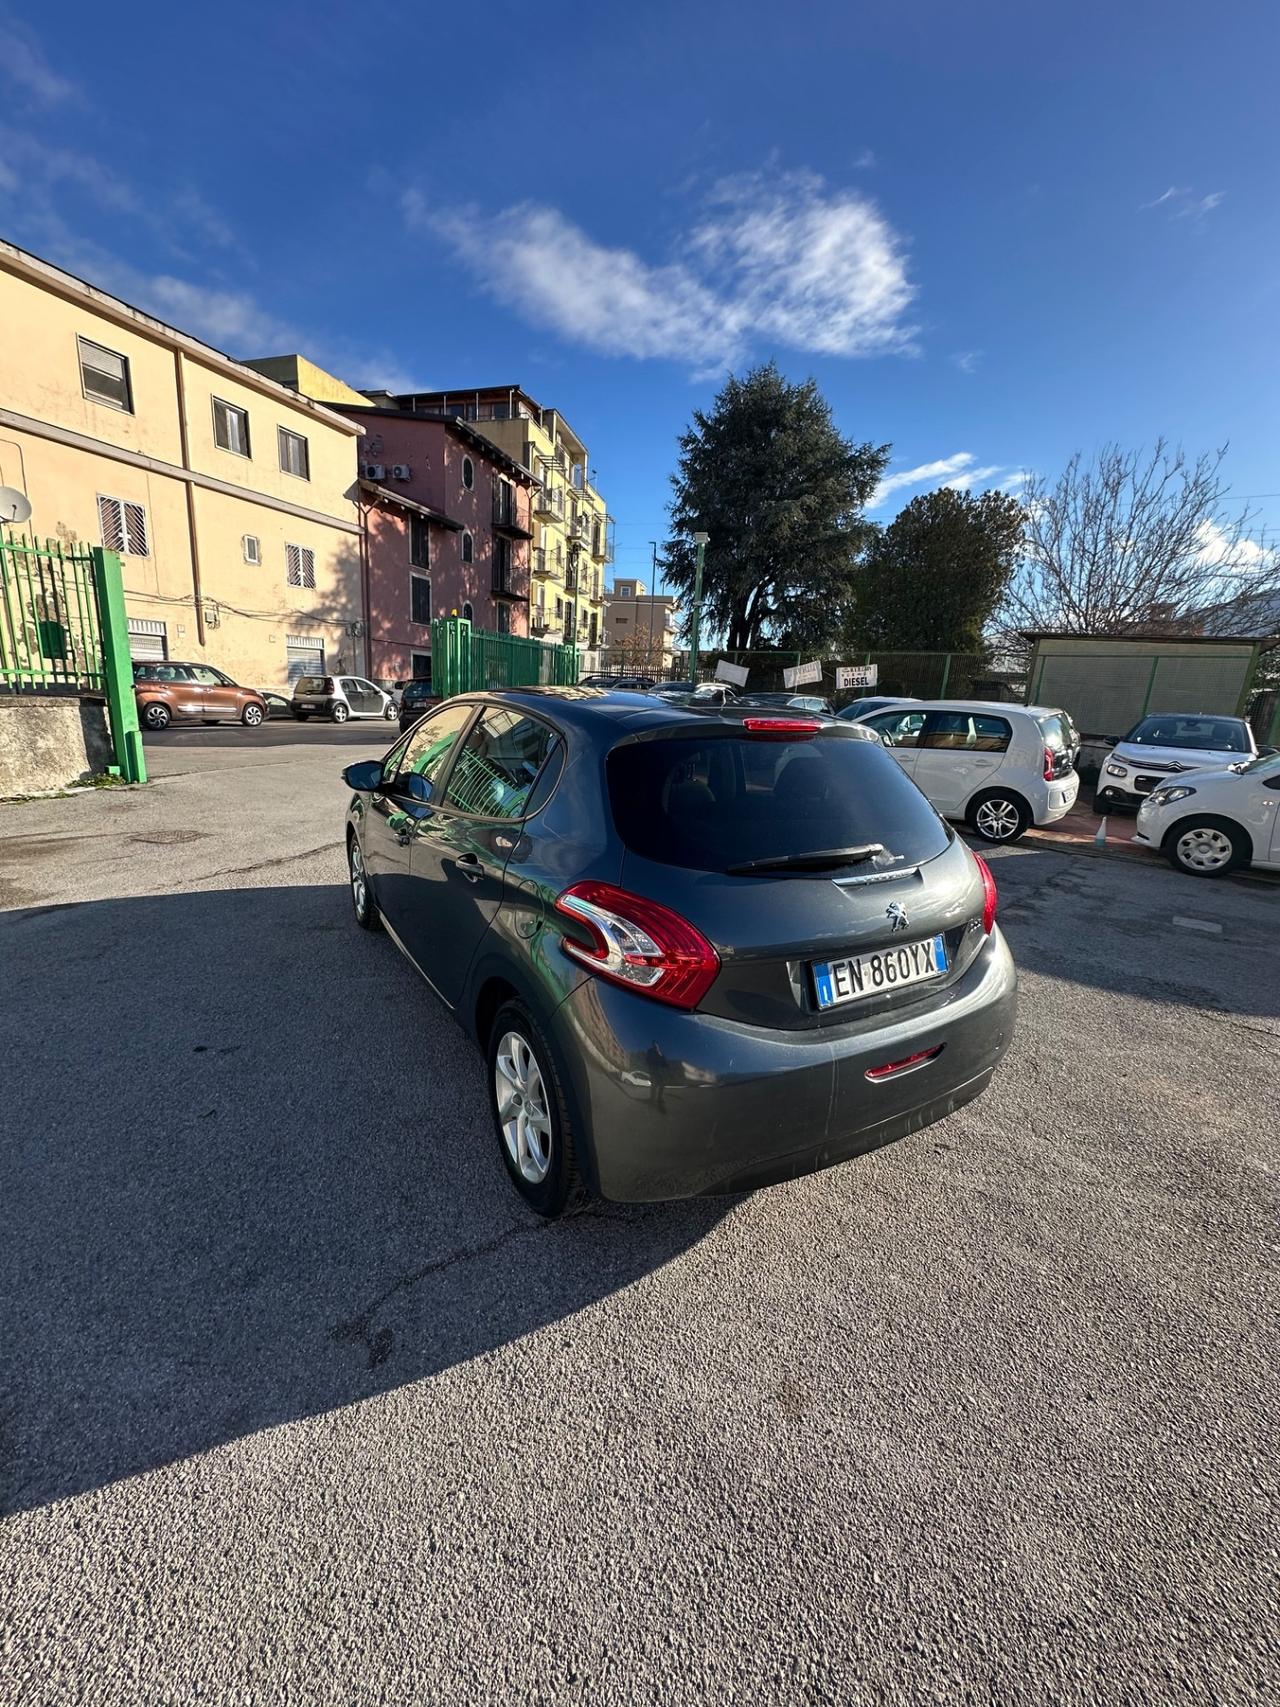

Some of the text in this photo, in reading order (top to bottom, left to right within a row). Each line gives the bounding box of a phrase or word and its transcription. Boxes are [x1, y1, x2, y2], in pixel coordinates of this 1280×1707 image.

[844, 677, 869, 686] DIESEL
[833, 959, 864, 997] EN
[871, 942, 934, 986] 860YX
